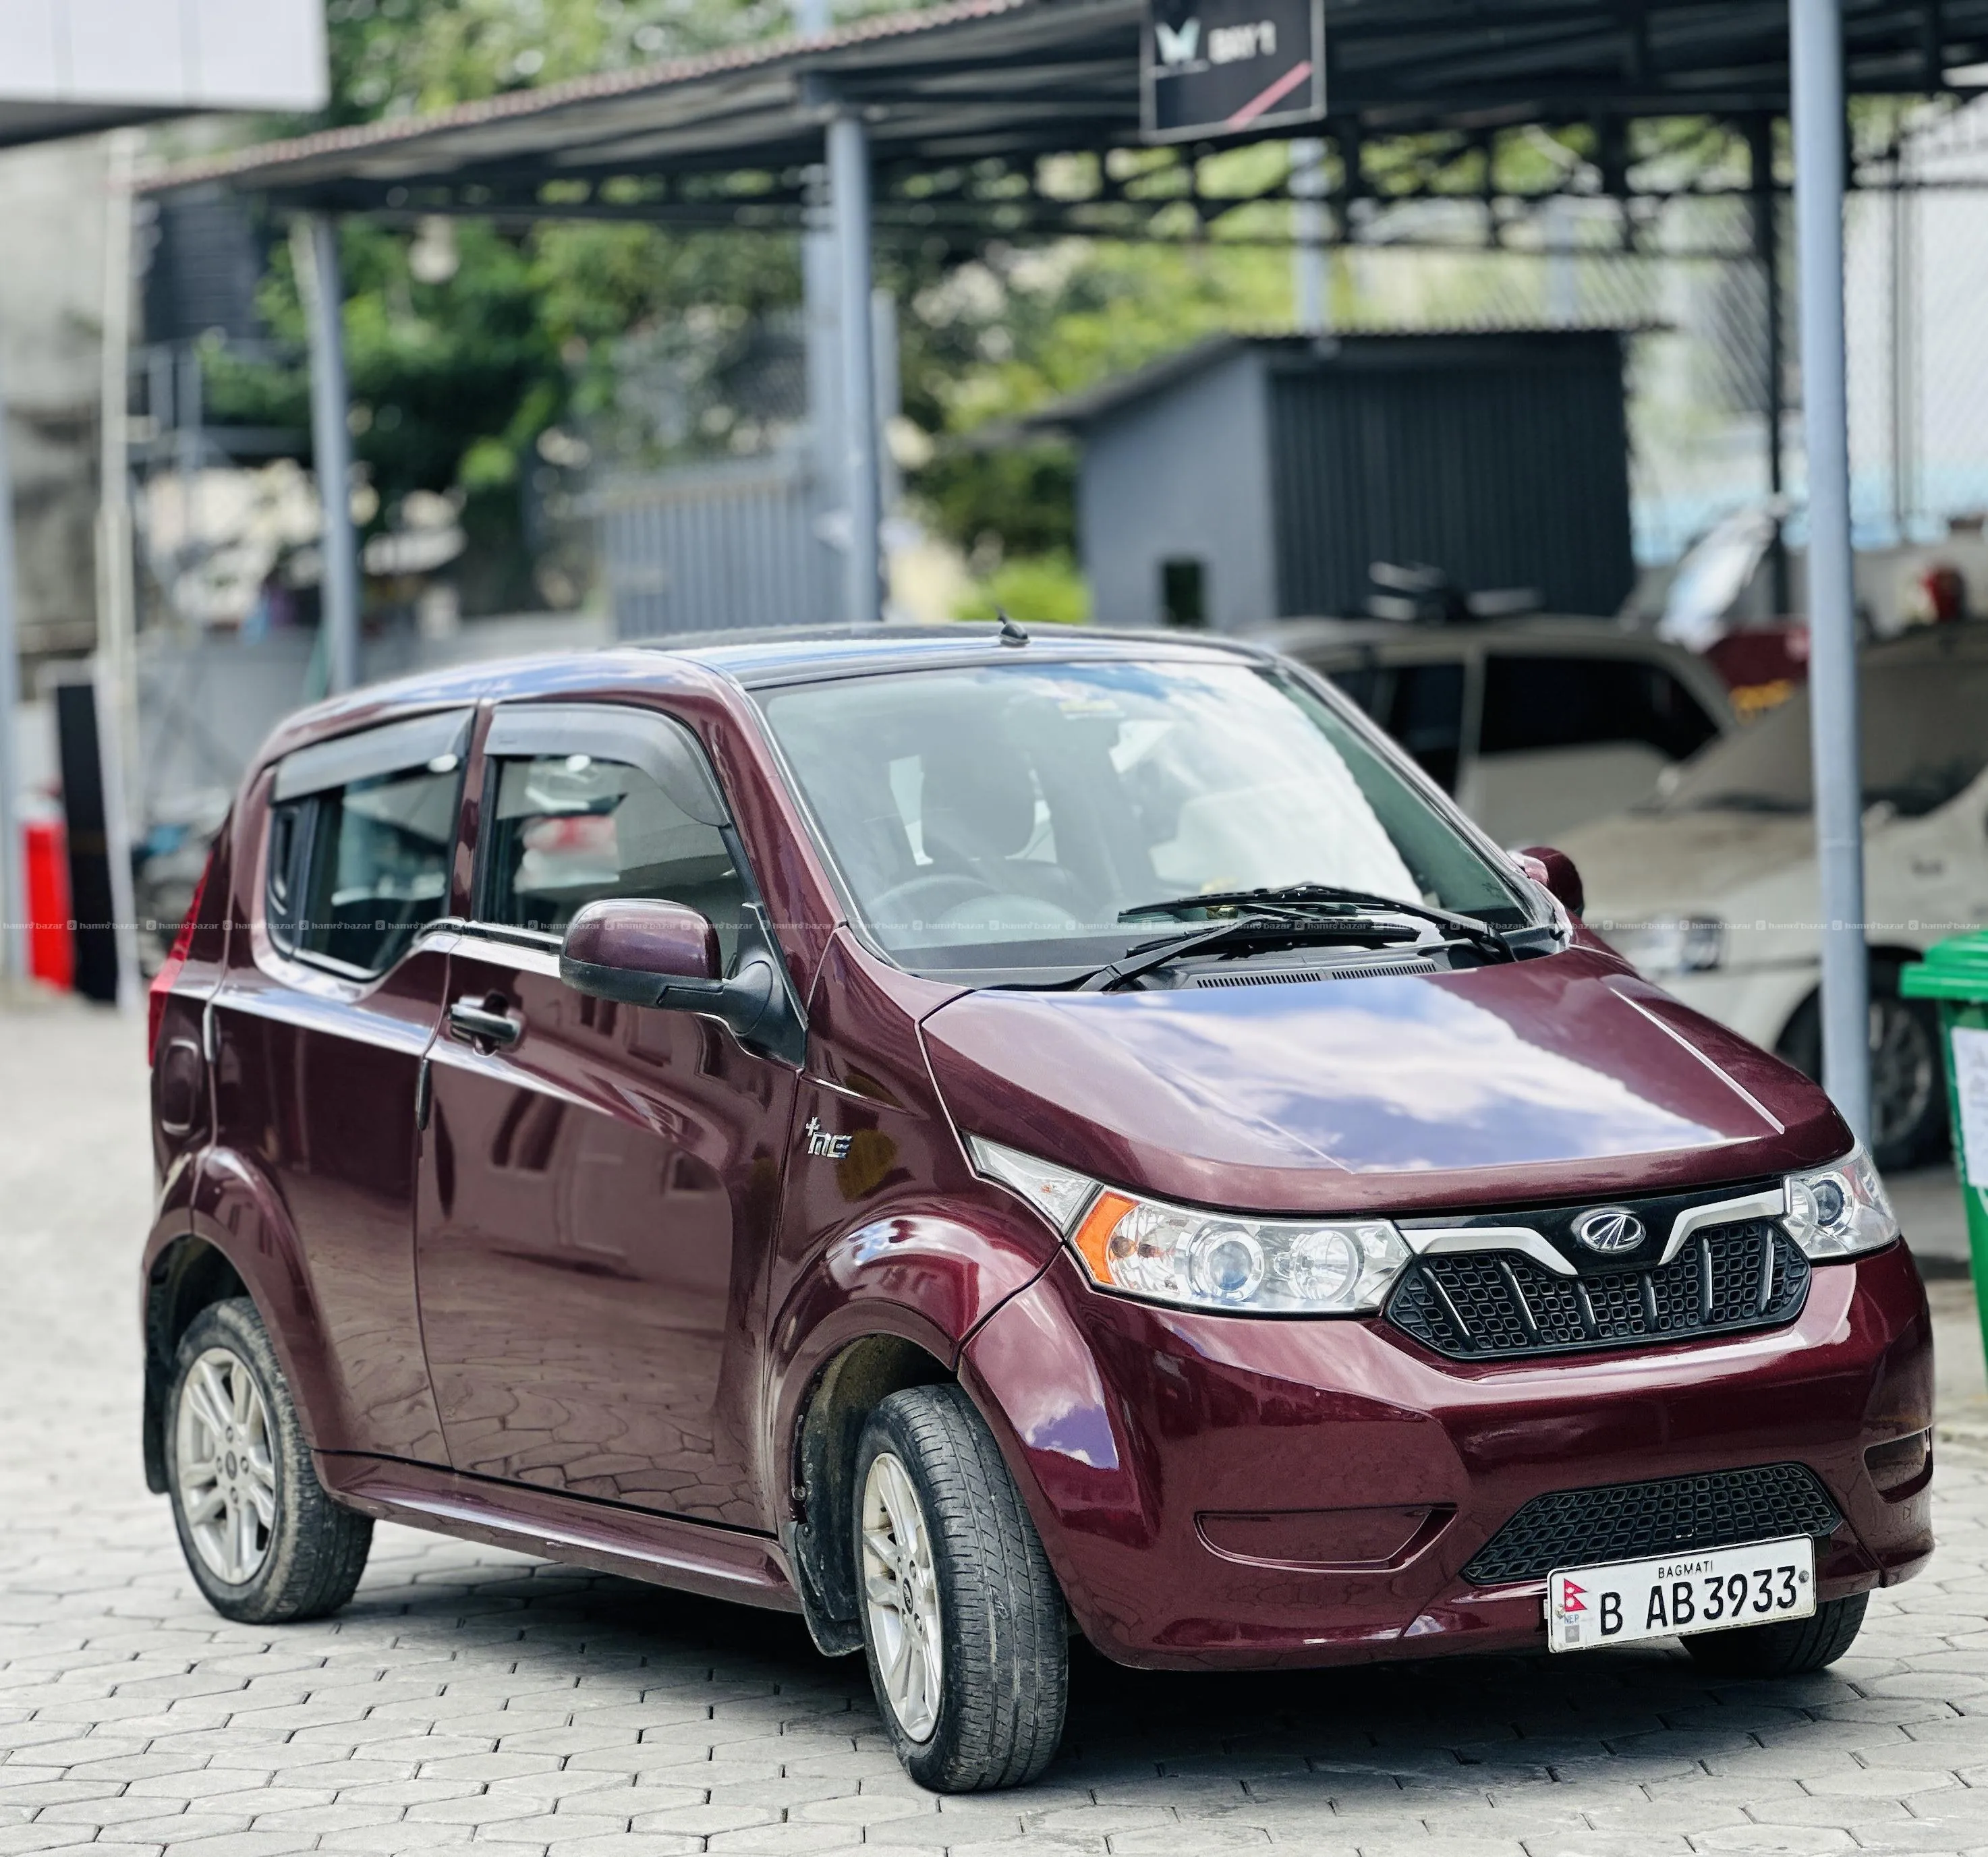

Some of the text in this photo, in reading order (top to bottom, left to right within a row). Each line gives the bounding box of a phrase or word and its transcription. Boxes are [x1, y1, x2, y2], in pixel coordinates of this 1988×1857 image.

[1657, 1560, 1713, 1579] BAGMATI
[1564, 1613, 1579, 1625] NEP
[1600, 1591, 1623, 1636] B
